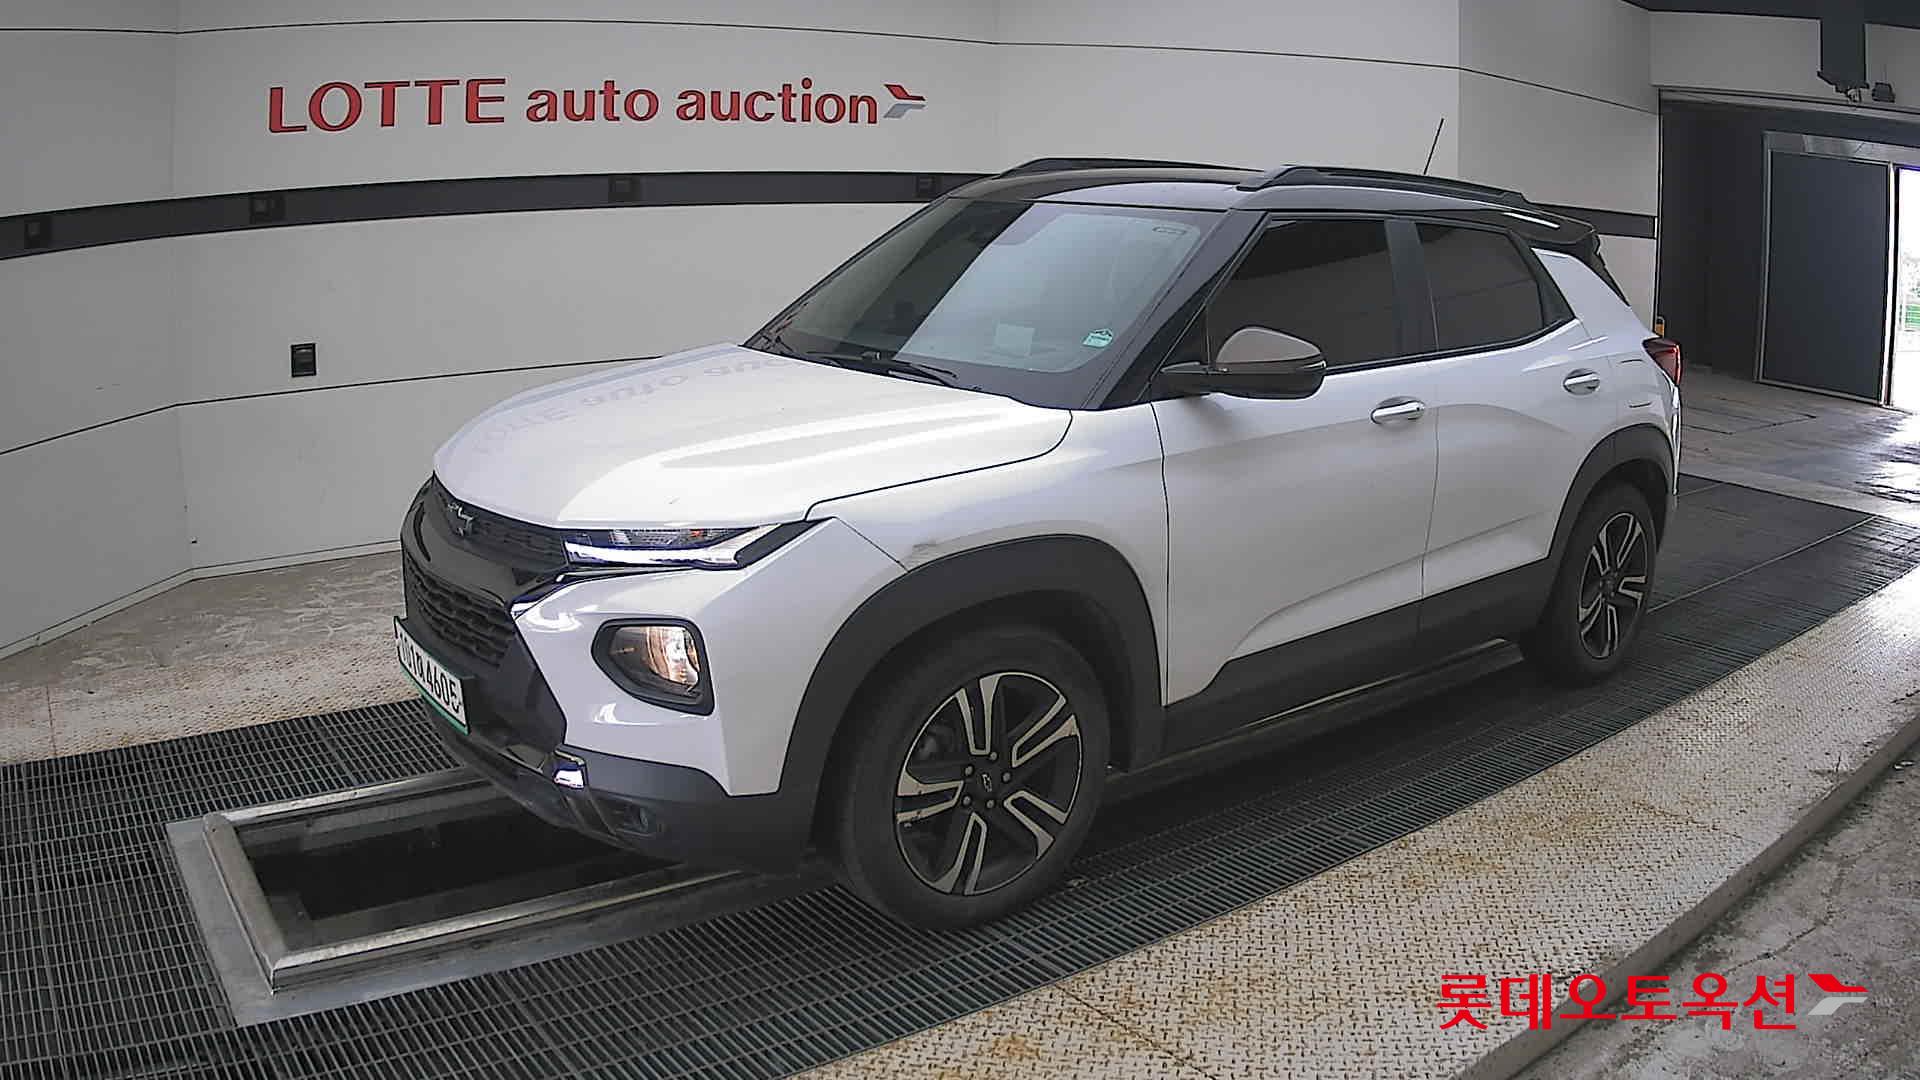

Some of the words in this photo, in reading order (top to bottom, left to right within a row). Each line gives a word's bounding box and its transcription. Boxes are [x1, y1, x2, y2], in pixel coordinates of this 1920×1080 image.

[268, 78, 506, 133] LOTTE
[526, 80, 659, 123] auto
[676, 78, 877, 124] auction
